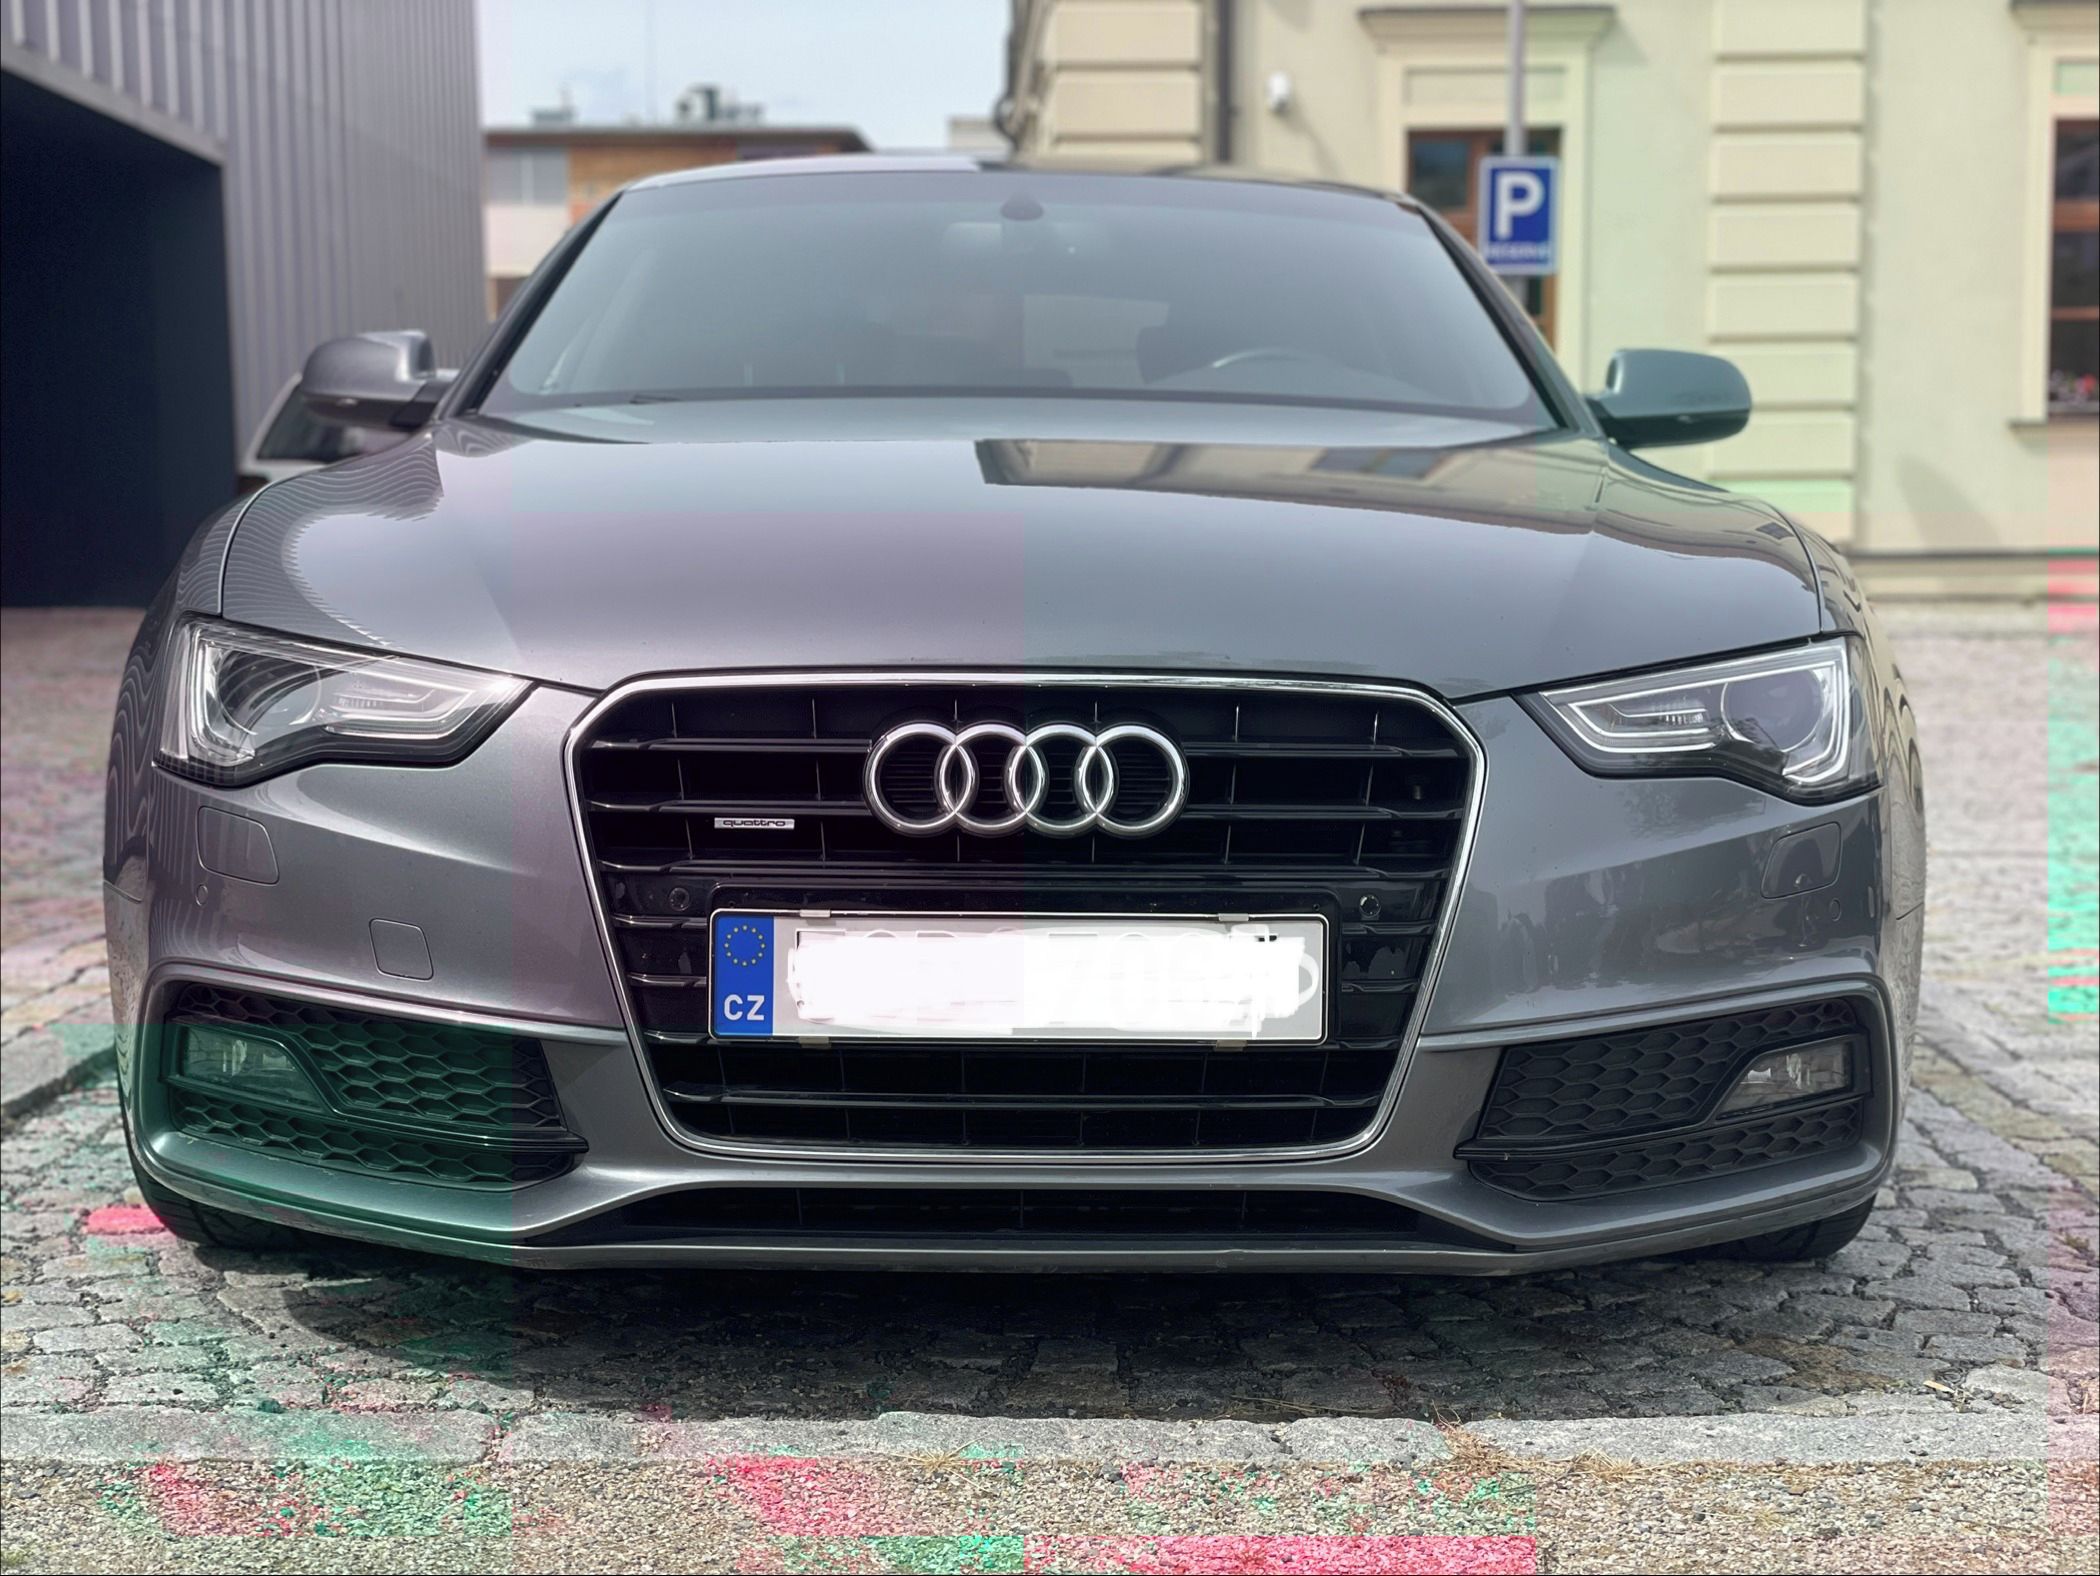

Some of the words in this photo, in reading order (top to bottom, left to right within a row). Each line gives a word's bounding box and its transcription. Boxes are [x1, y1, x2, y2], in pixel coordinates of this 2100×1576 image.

[1495, 171, 1544, 239] P
[723, 819, 786, 828] quattro
[724, 994, 765, 1021] CZ
